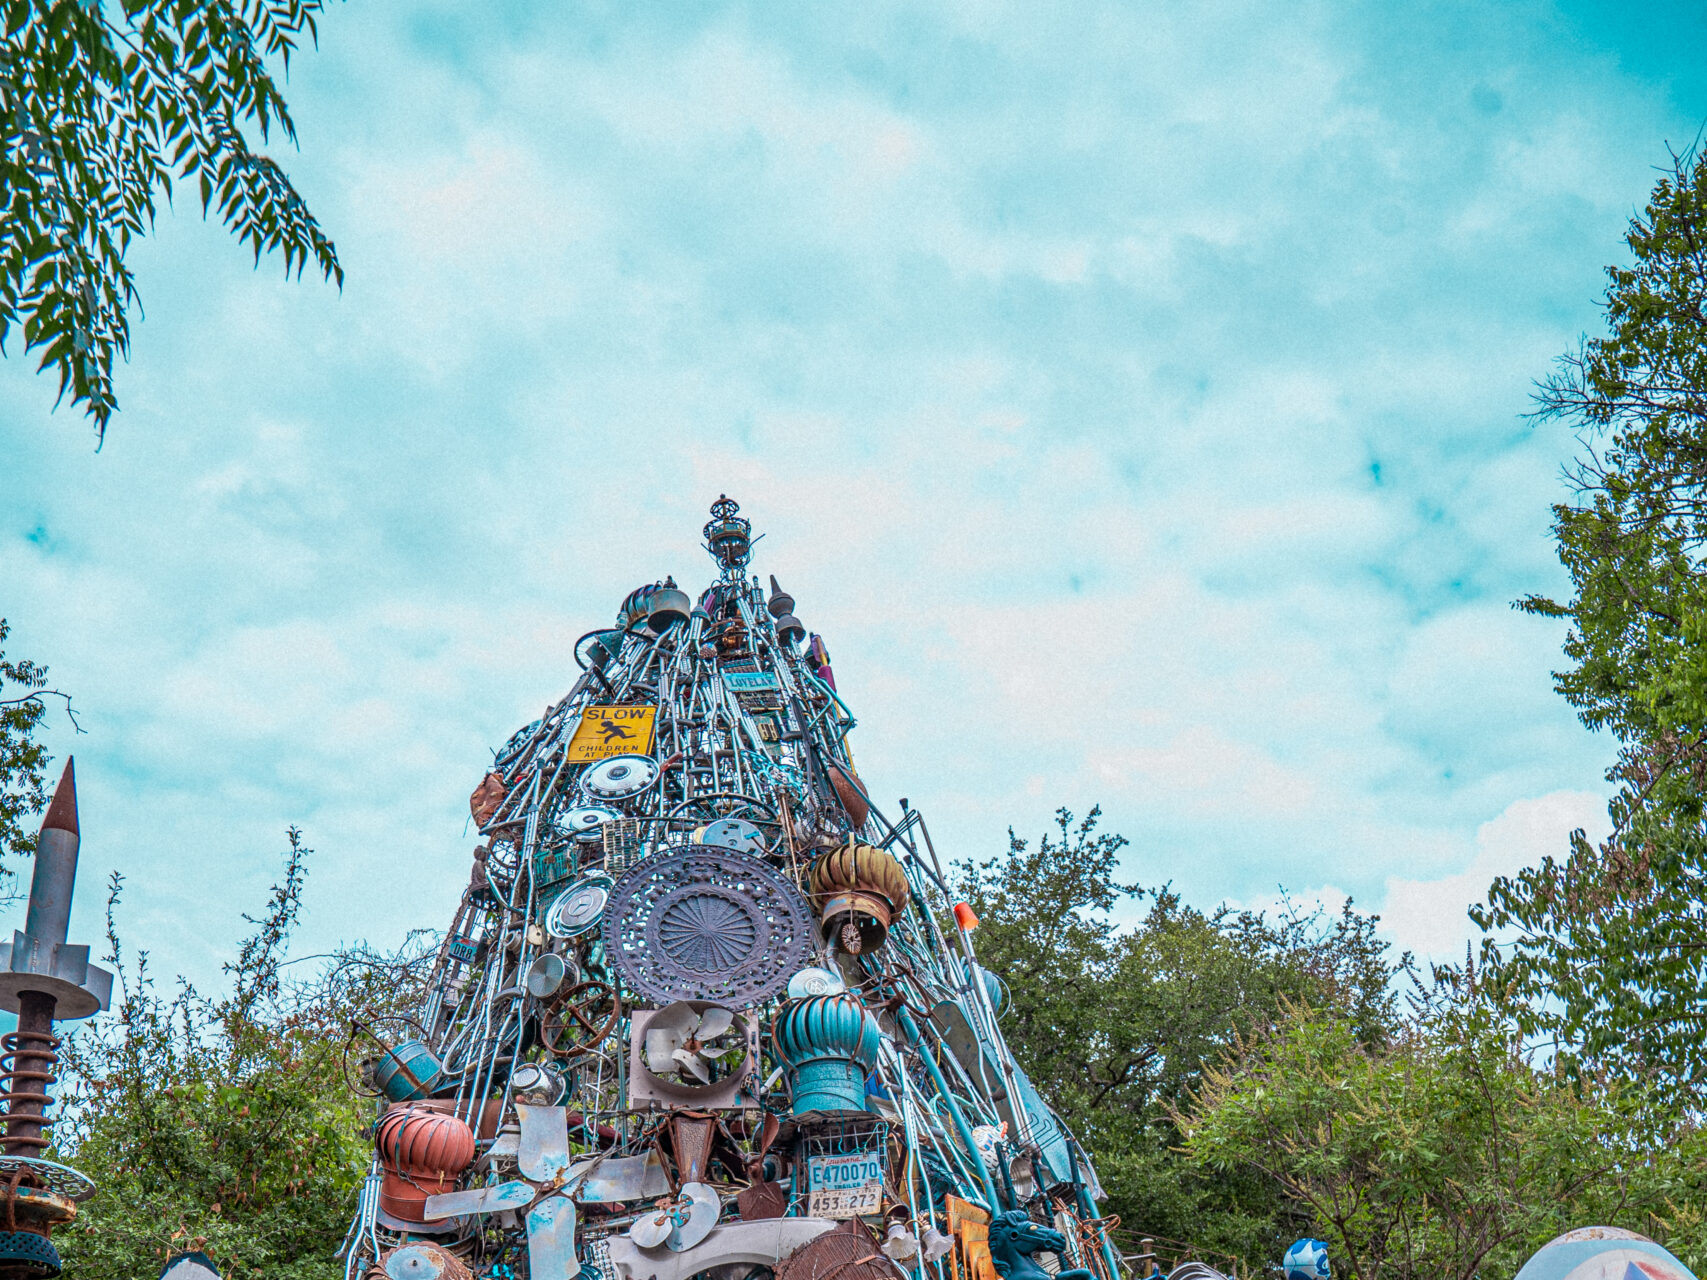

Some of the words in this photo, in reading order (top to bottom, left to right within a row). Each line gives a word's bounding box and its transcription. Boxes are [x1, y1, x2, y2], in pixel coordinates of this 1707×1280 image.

[586, 709, 646, 720] SLOW
[813, 1162, 878, 1184] E470070
[812, 1197, 840, 1212] 453
